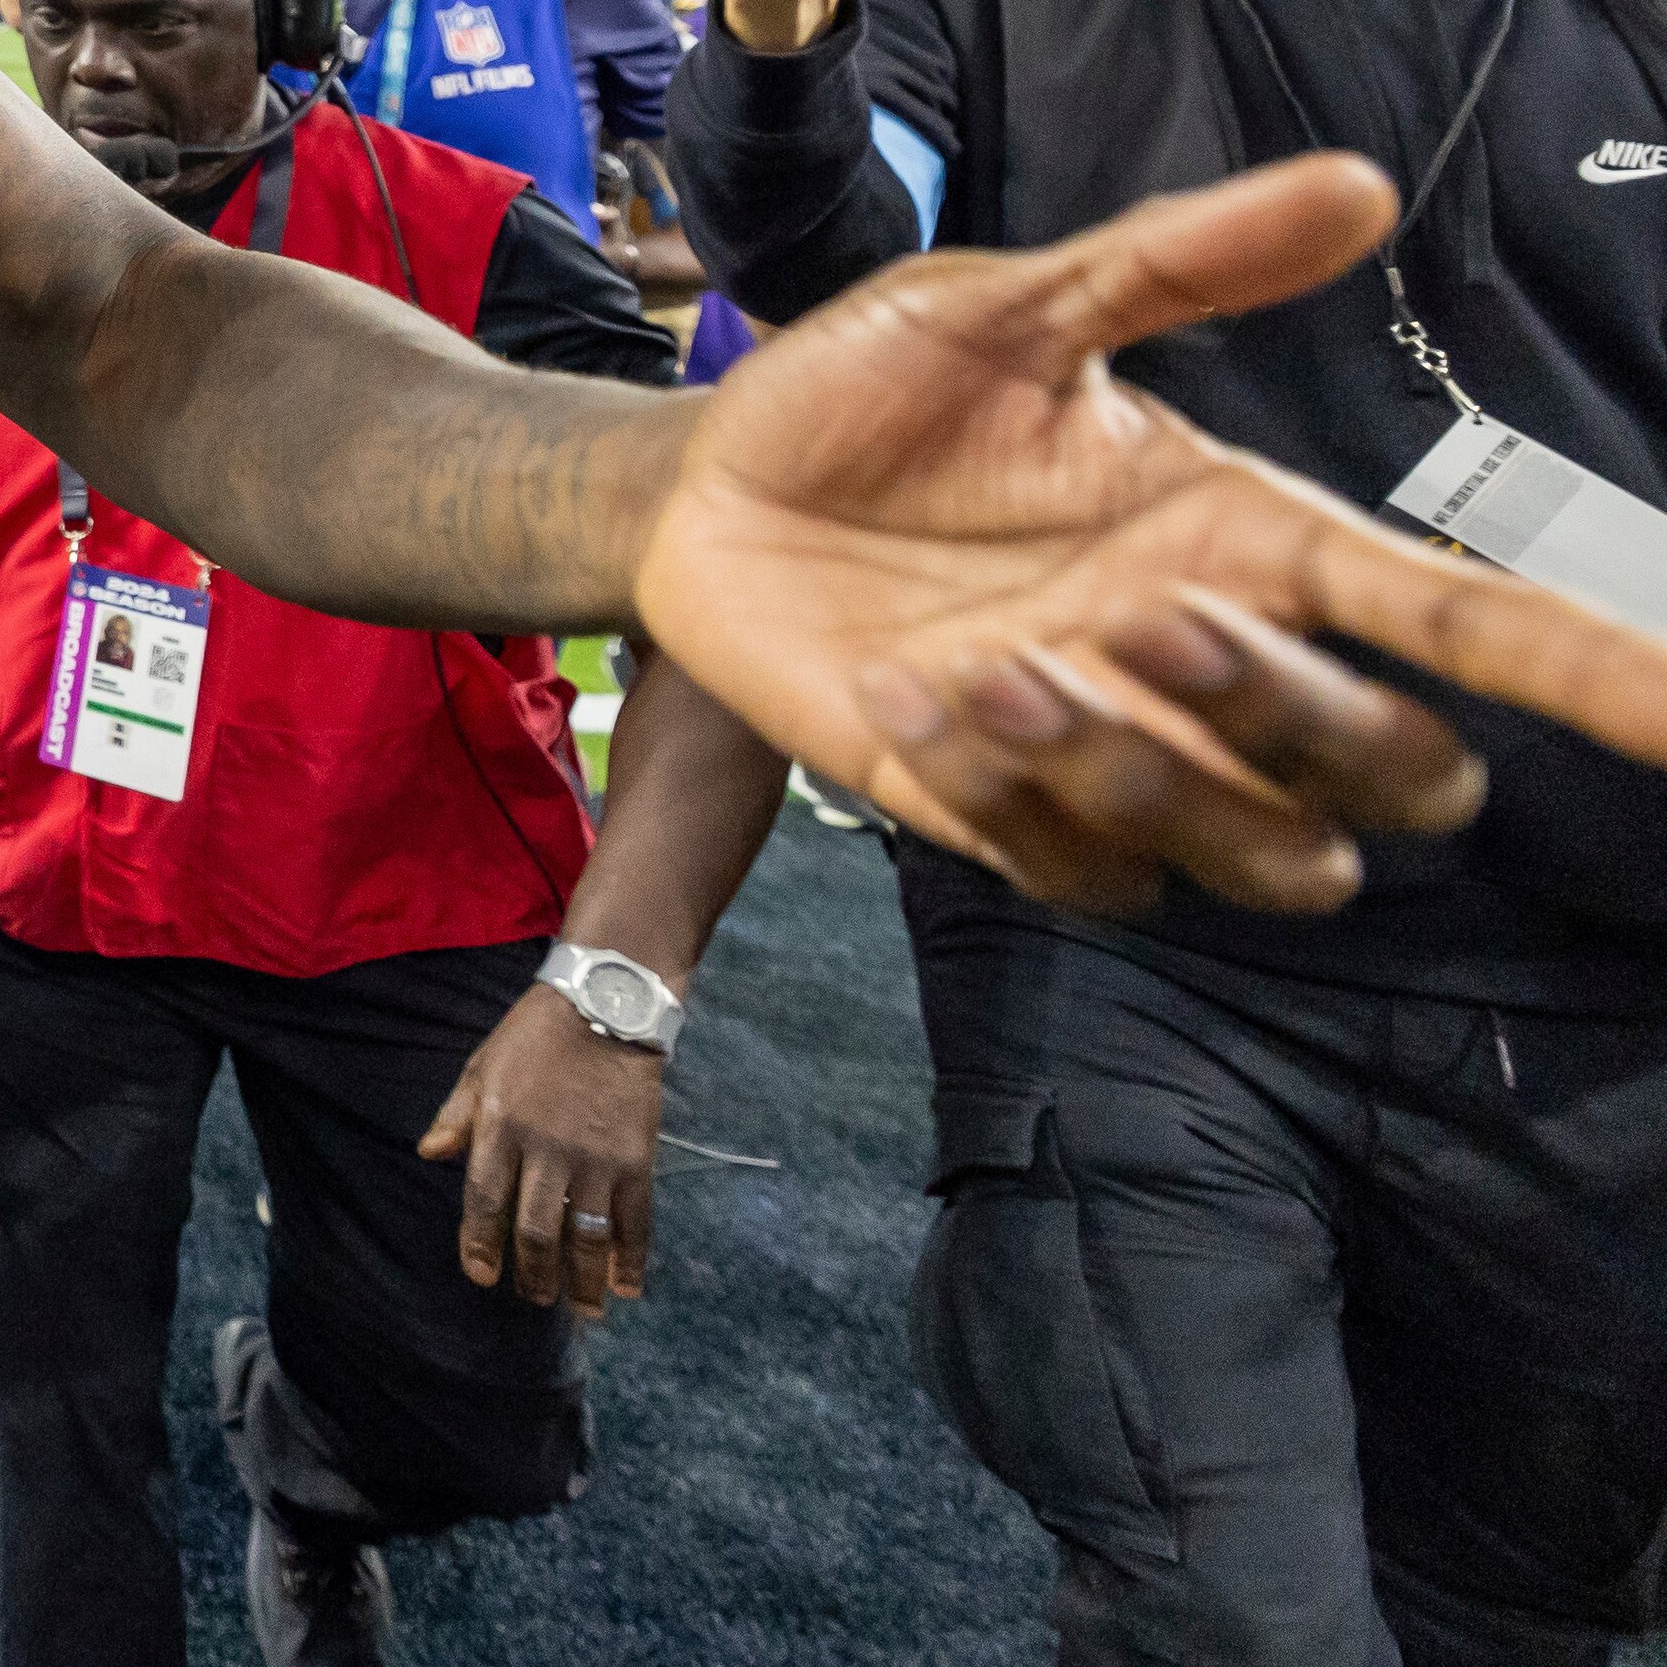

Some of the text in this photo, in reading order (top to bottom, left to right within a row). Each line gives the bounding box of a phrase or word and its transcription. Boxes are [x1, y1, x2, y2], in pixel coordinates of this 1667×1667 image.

[1597, 138, 1667, 169] NIKE
[89, 586, 187, 621] SEASON
[46, 601, 86, 762] BROADCAST
